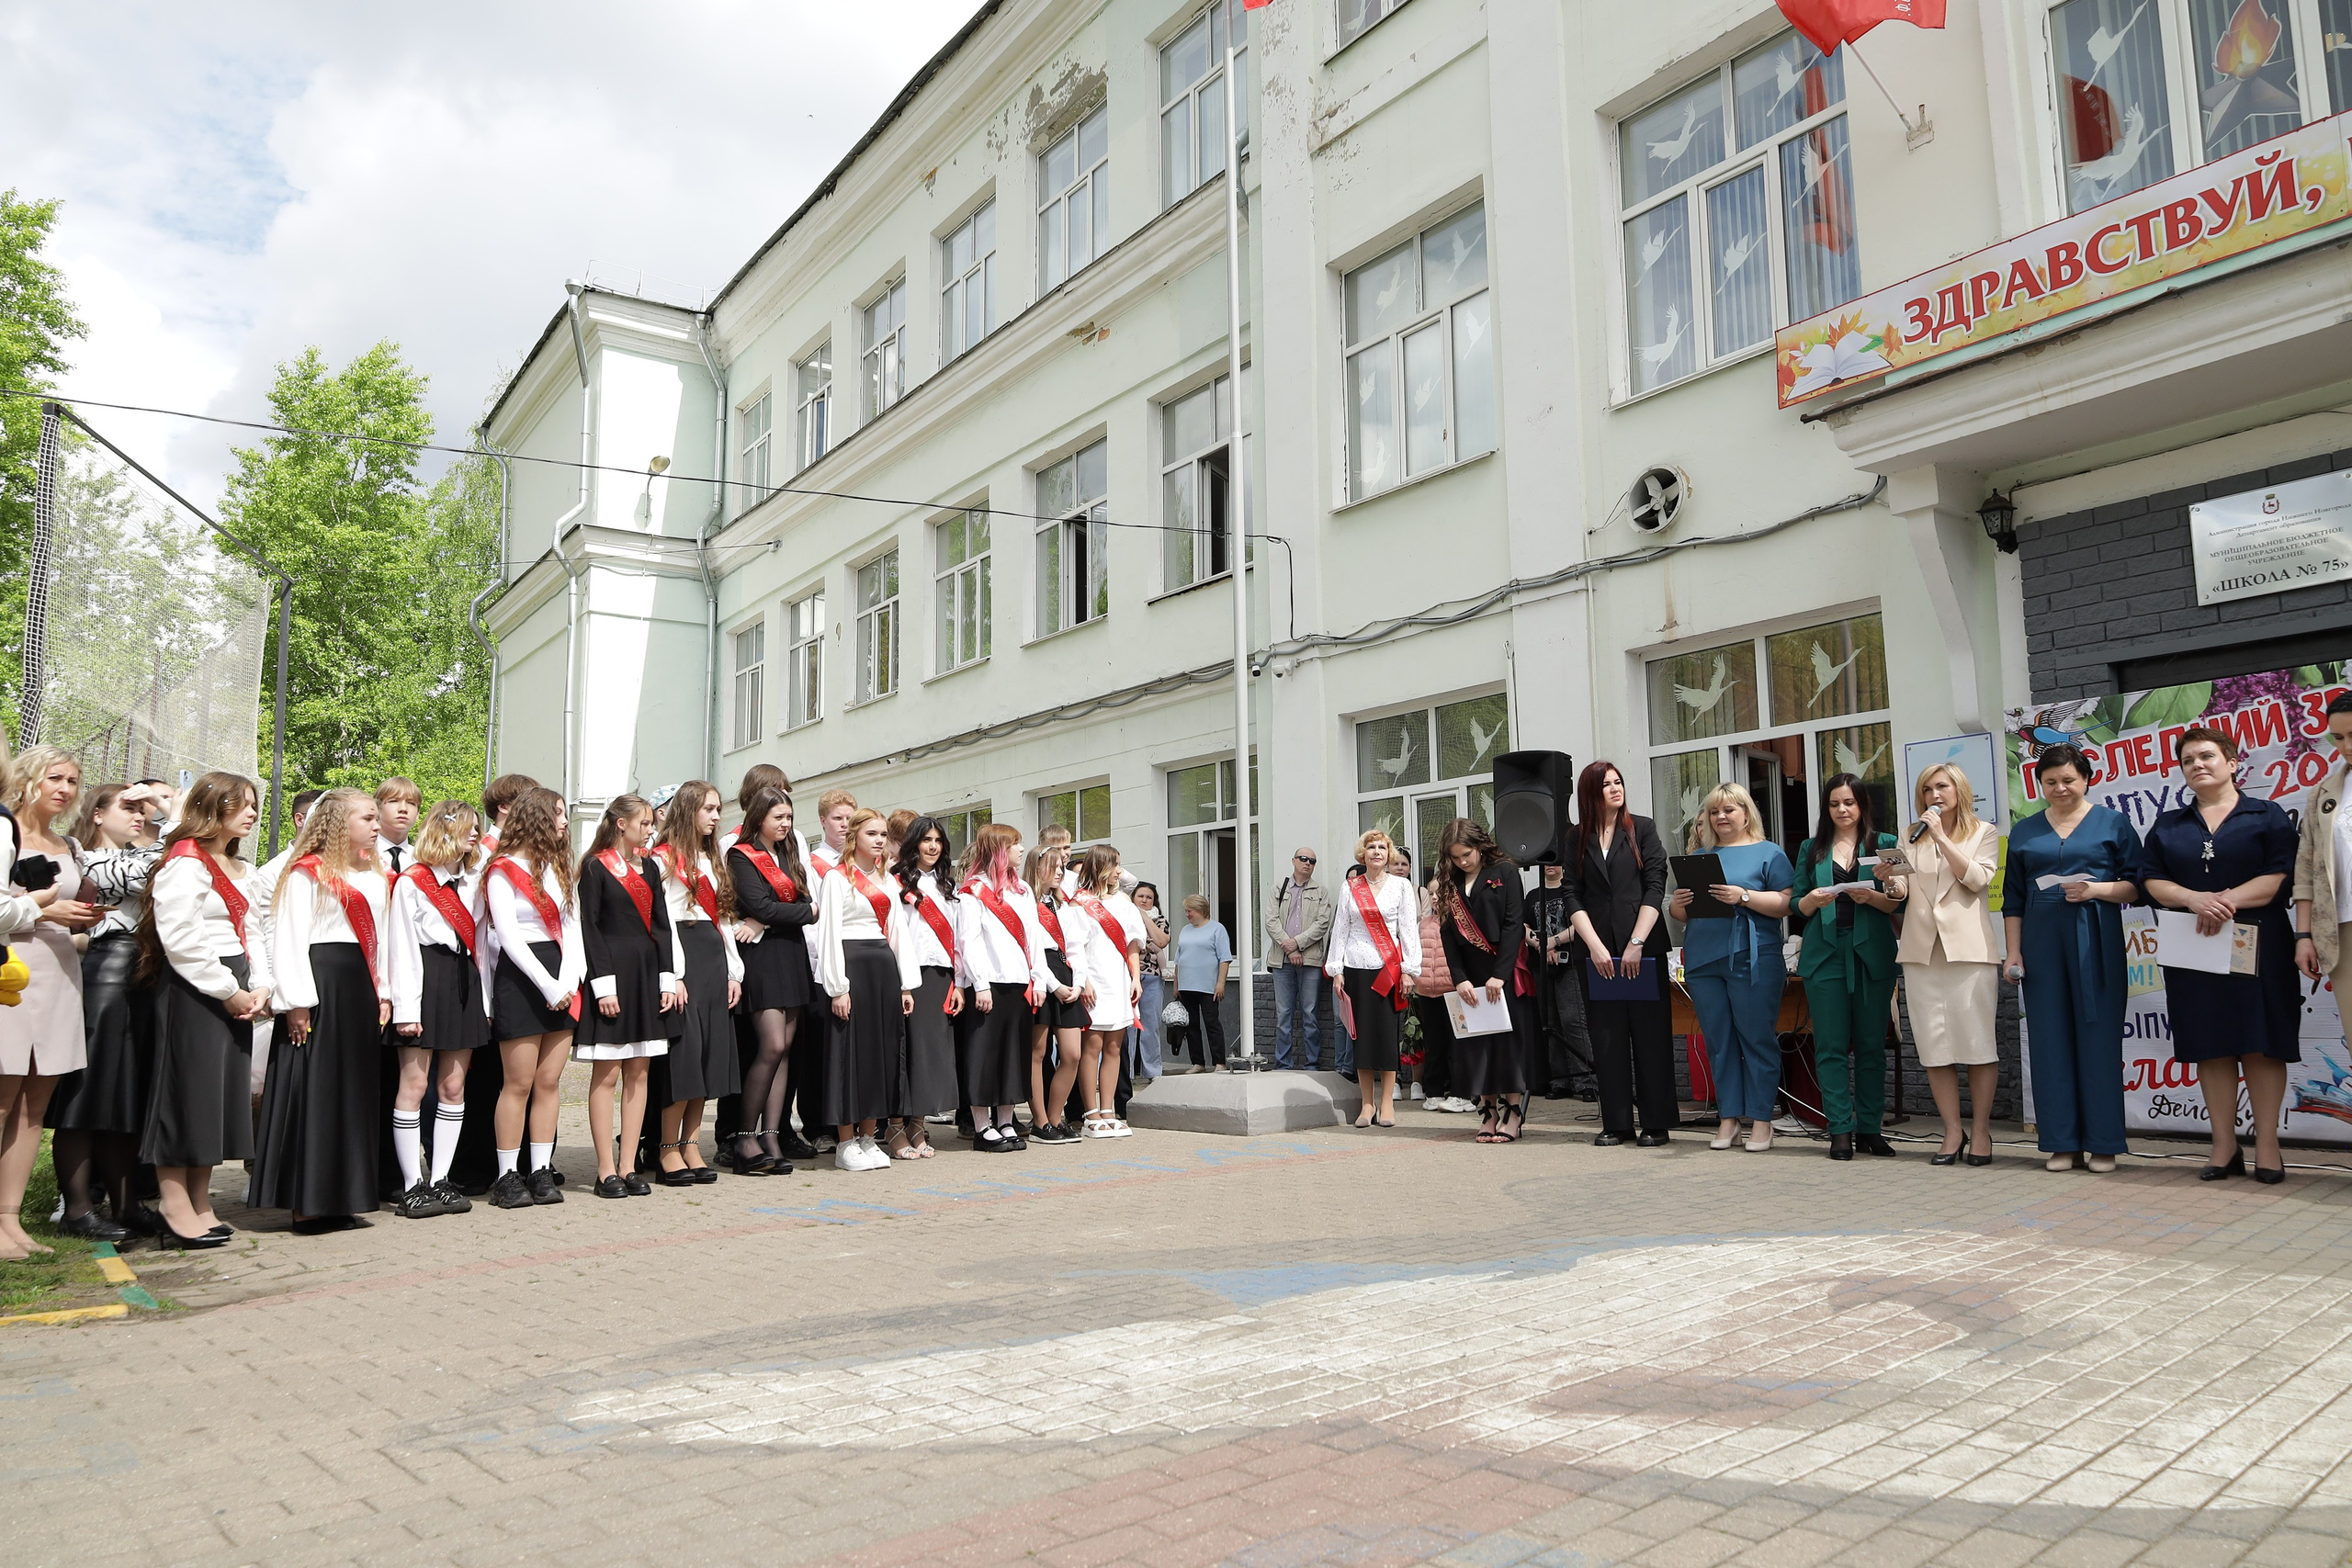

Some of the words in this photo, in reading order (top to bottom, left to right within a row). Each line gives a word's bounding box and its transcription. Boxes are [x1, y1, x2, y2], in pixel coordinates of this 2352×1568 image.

[1903, 150, 2324, 344] ЗДРАВСТВУЙ,
[2208, 523, 2256, 537] Администрация
[2258, 516, 2280, 528] города
[2281, 510, 2312, 522] Нижнего
[2235, 525, 2278, 538] Департамент
[2279, 516, 2322, 529] образования
[2210, 537, 2284, 558] МУНИЦИПАЛЬНОЕ
[2286, 526, 2345, 544] БЮДЖЕТНОЕ
[2224, 536, 2330, 563] ОБЩЕОБРАЗОВАТЕЛЬНОЕ
[2247, 549, 2306, 566] УЧРЕЖДЕНИЕ
[2211, 569, 2291, 593] «ШКОЛА
[2295, 563, 2318, 578] №
[2322, 558, 2349, 572] 75»
[2022, 697, 2289, 800] ПСЛЕДНИЙ
[422, 874, 474, 940] Выпускница
